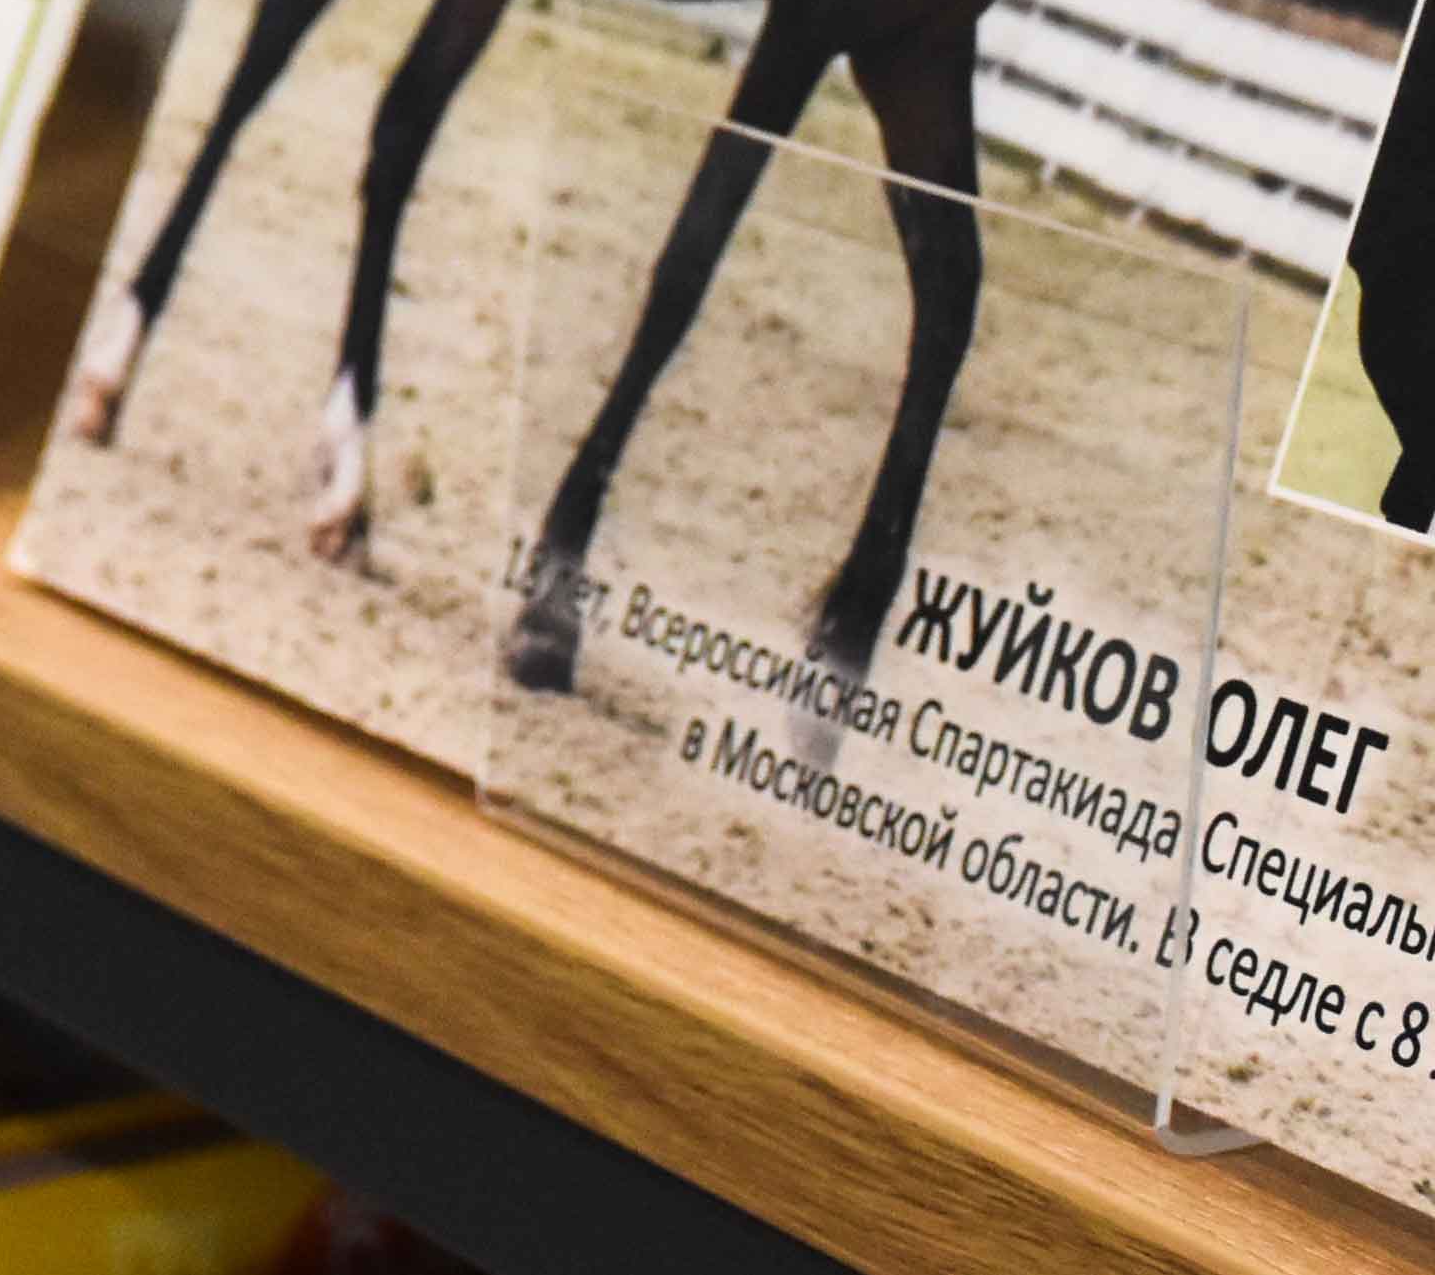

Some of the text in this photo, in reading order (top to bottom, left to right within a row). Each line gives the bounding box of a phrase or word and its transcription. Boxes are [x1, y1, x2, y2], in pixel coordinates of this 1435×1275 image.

[620, 582, 901, 743] Всероссийская
[909, 698, 1183, 862] Спартакиада
[896, 568, 1390, 814] ЖУЙКОВ ОЛЕГ
[679, 716, 708, 763] в
[710, 720, 960, 871] Московской
[960, 832, 1139, 954] области.
[1154, 905, 1200, 968] В
[1205, 936, 1345, 1034] седле
[1354, 999, 1385, 1051] с
[1391, 1001, 1430, 1068] 8
